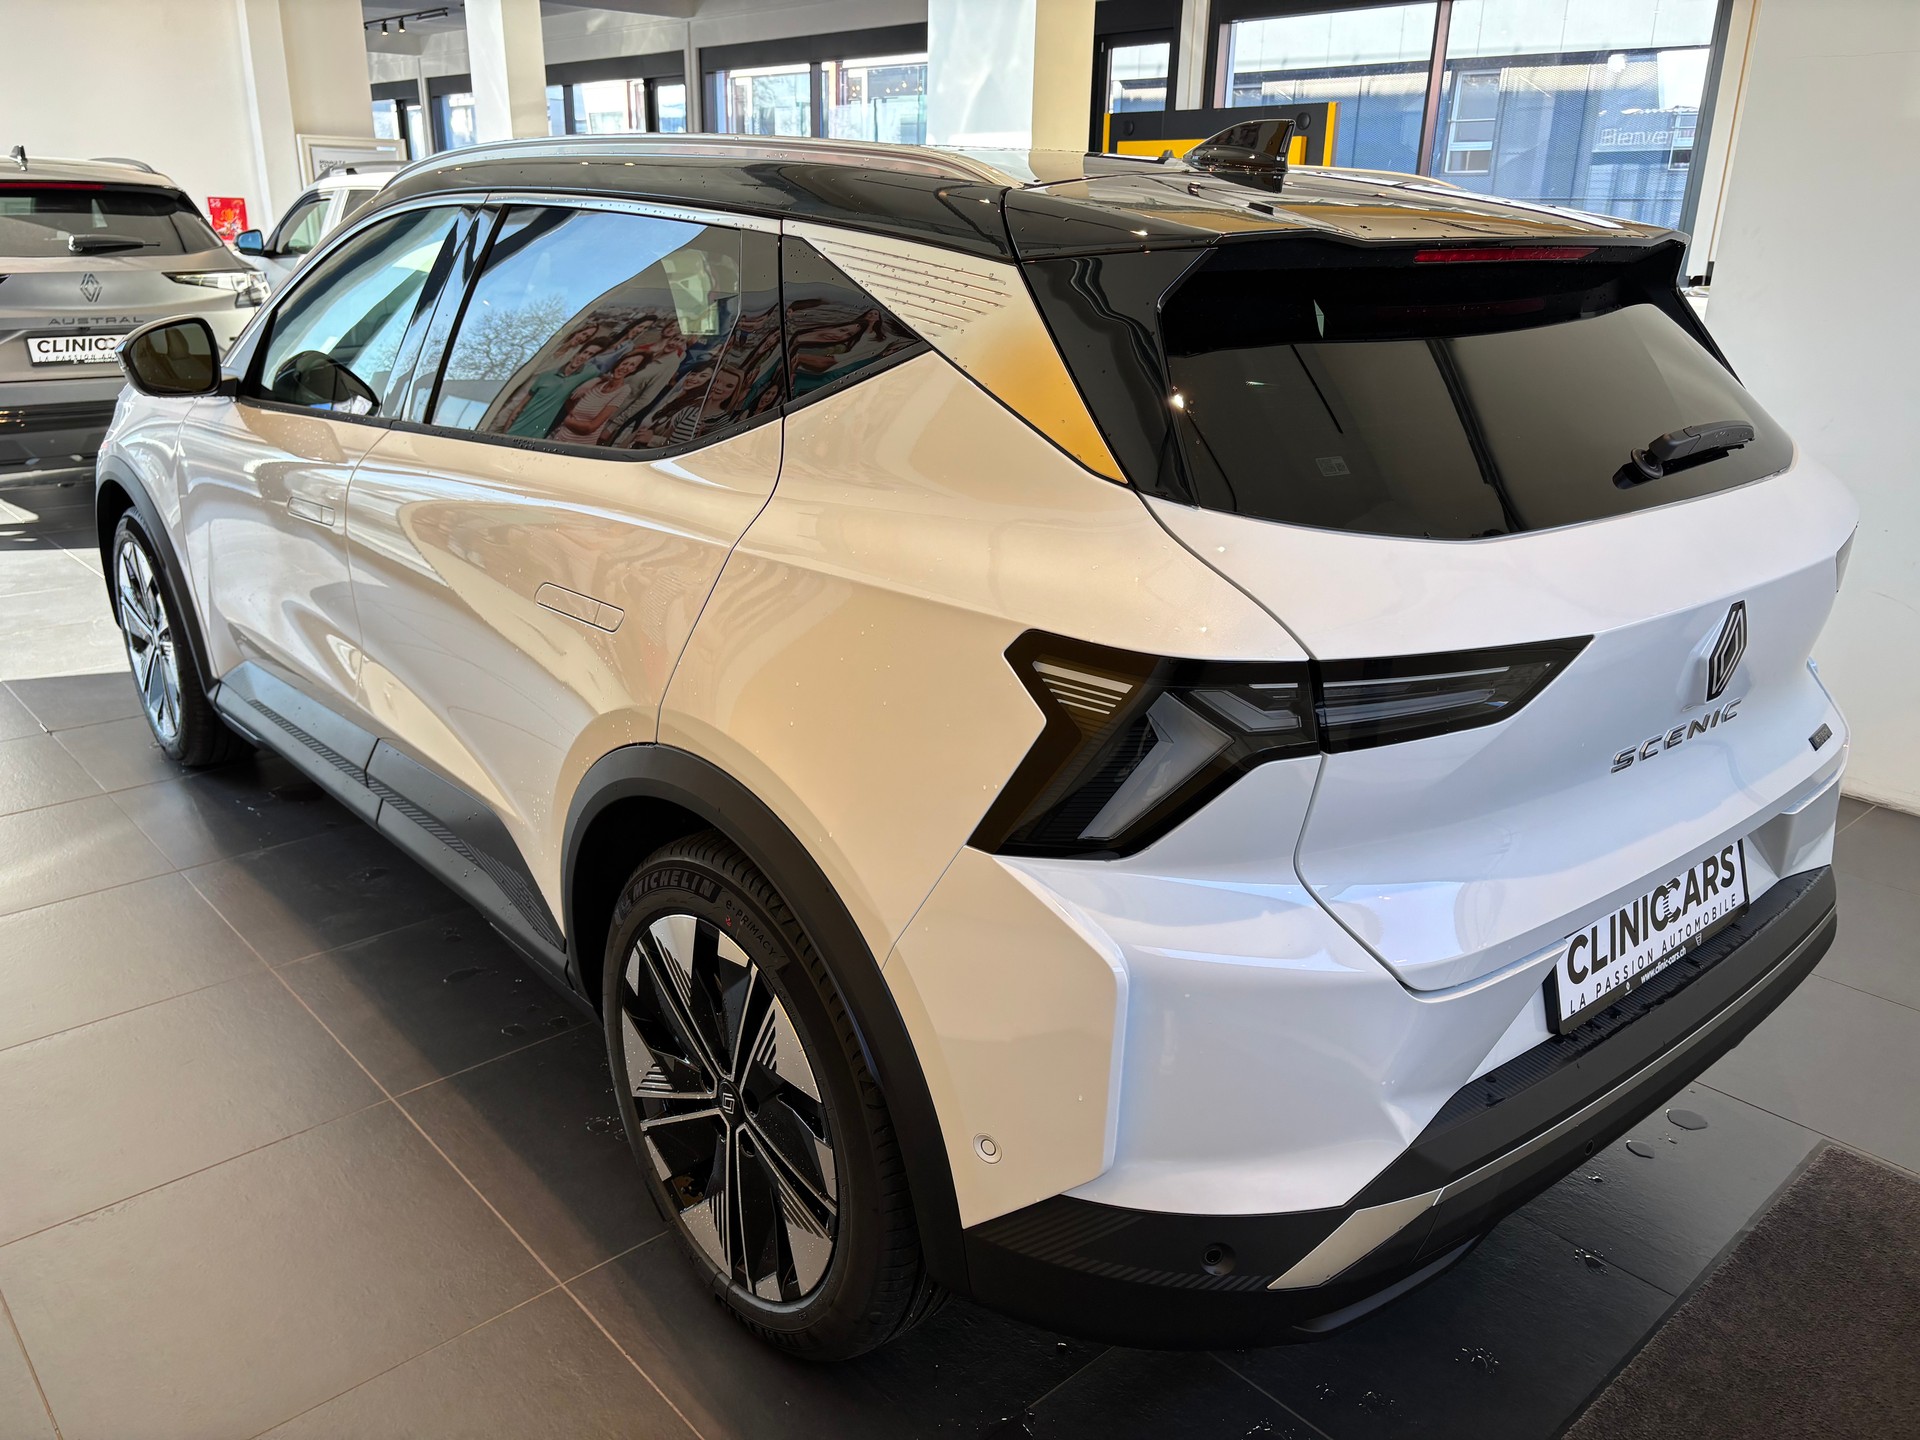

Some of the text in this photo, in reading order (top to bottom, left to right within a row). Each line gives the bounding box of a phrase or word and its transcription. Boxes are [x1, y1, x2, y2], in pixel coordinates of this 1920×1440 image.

[48, 316, 145, 326] AUSTRAL
[37, 337, 117, 353] CLINICC
[1610, 697, 1742, 774] SCENIC
[632, 869, 717, 899] MICHELIN
[1569, 892, 1736, 1015] LA PASSION AUTOMOBILE
[1640, 945, 1687, 985] www.clinic-cars.ch
